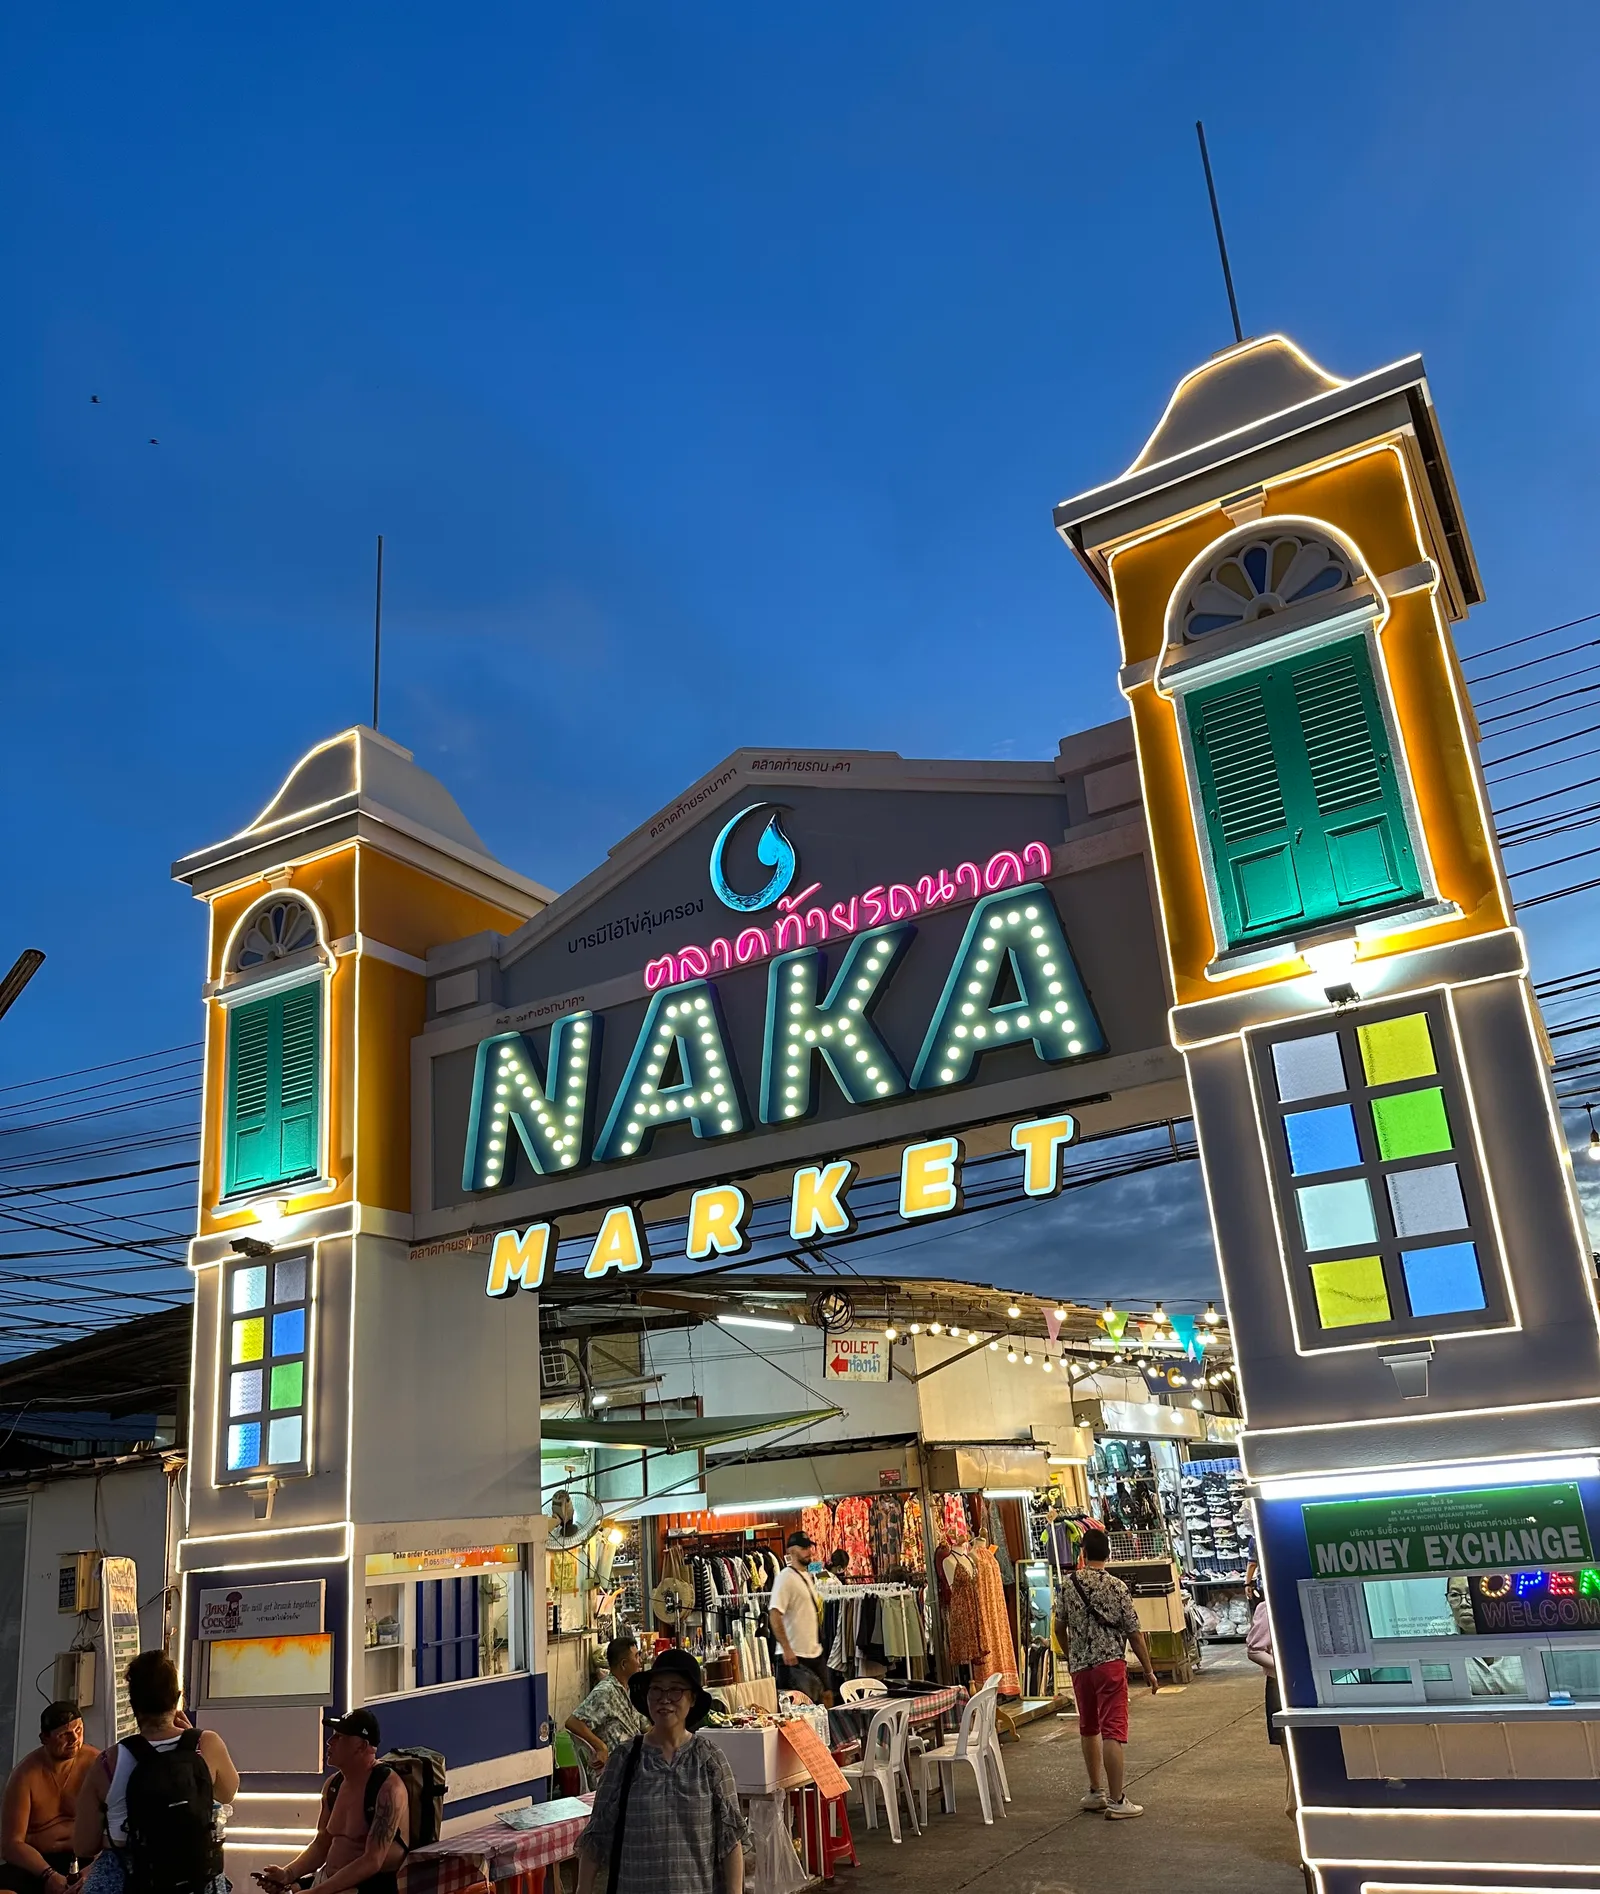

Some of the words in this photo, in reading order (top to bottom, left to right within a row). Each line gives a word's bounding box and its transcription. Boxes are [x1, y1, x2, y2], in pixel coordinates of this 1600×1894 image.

[644, 841, 1052, 991] ตลาดท้ายรถนาคา
[462, 883, 1110, 1192] NAKA
[486, 1113, 1081, 1297] MARKET
[831, 1340, 879, 1354] TOILET
[1315, 1538, 1409, 1574] MONEY
[1423, 1526, 1585, 1567] EXCHANGE
[1349, 1527, 1375, 1537] บริการ
